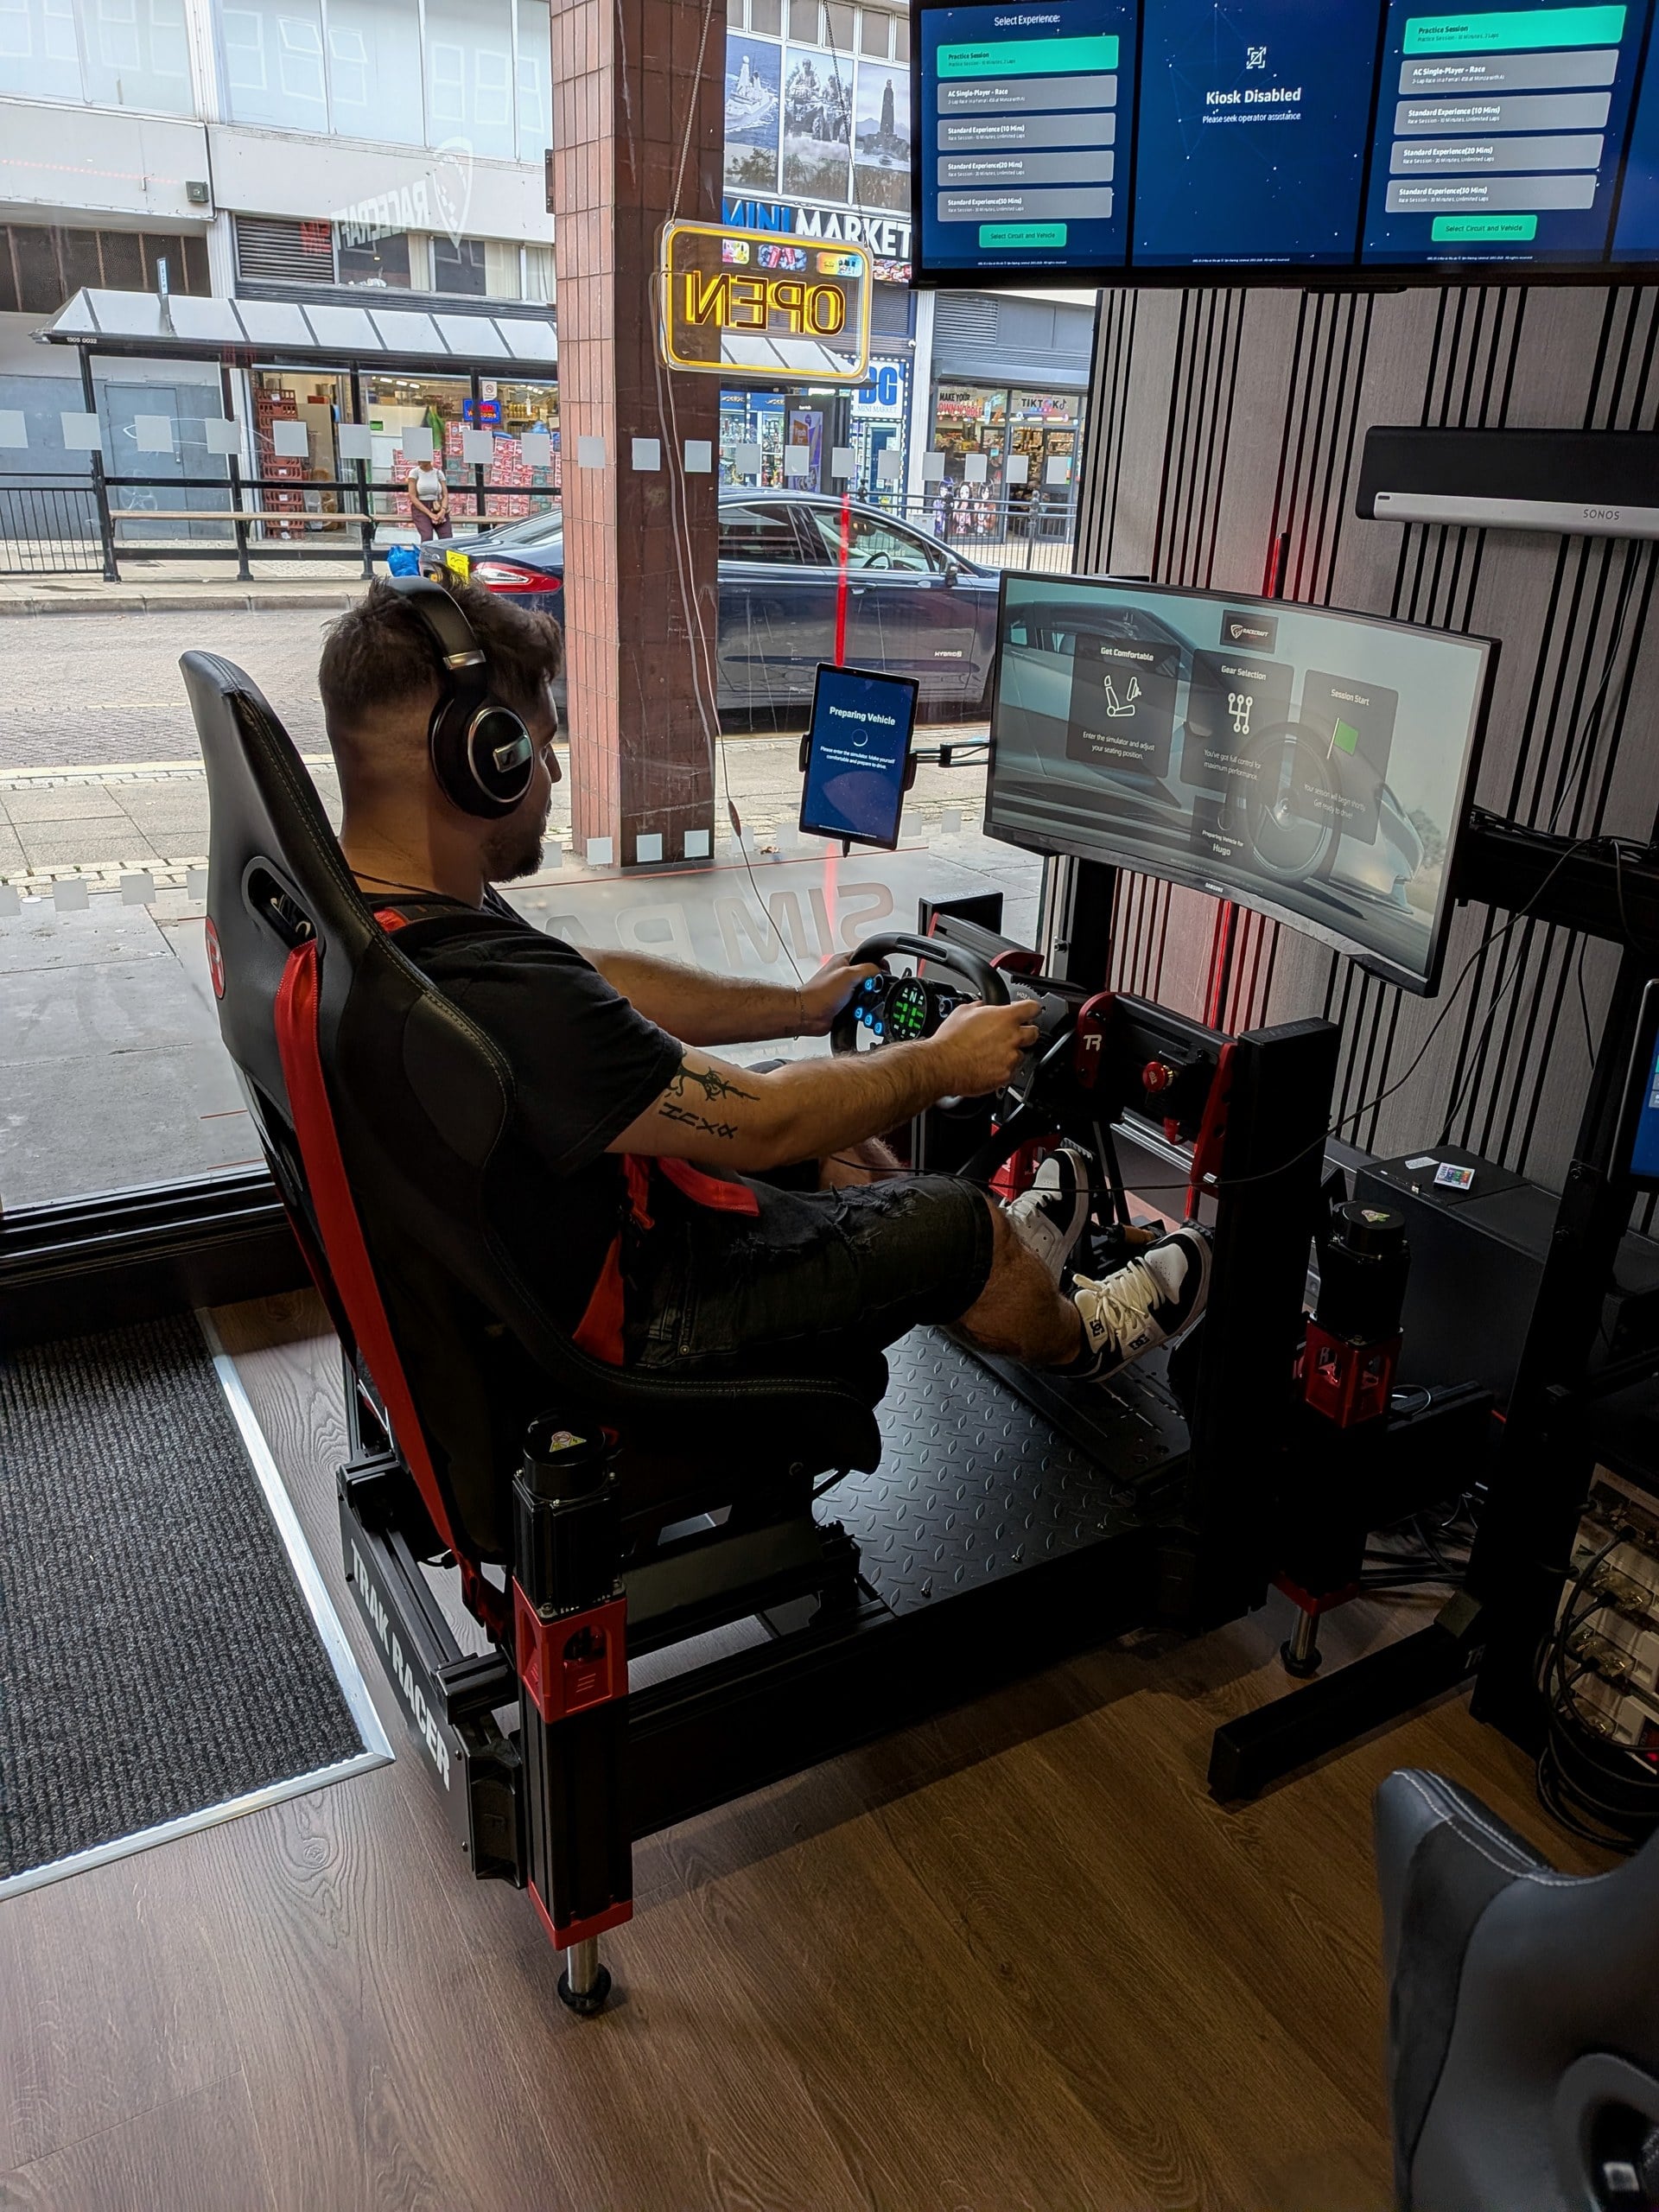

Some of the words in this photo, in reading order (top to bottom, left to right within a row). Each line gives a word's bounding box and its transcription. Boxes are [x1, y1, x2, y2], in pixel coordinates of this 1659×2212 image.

[994, 16, 1018, 26] Select
[1018, 14, 1060, 26] Experience:
[1422, 67, 1465, 76] Single-Player
[956, 89, 991, 98] Single-Player
[1206, 91, 1241, 105] Kiosk
[1244, 87, 1301, 103] Disabled
[1438, 107, 1471, 117] Experience
[1471, 107, 1482, 116] (10
[1483, 105, 1500, 114] Mins)
[1203, 114, 1223, 124] Please
[1224, 114, 1237, 123] seek
[1238, 114, 1266, 124] operator
[1433, 148, 1474, 156] Experience(20
[722, 197, 791, 233] MINI
[795, 207, 912, 258] MARKET
[938, 392, 955, 401] MAKE
[956, 392, 970, 402] YOUR
[1583, 509, 1620, 520] SONOS
[1243, 627, 1268, 638] RACECRAFT
[1113, 648, 1154, 661] Comfortable
[1221, 665, 1236, 675] Gear
[1237, 669, 1267, 681] Selection
[1331, 689, 1354, 702] Session
[1355, 695, 1370, 705] Start
[830, 706, 866, 722] Preparing
[868, 712, 896, 726] Vehicle
[1083, 731, 1096, 740] Enter
[1096, 733, 1106, 741] the
[1106, 735, 1128, 746] simulator
[1128, 740, 1139, 748] and
[1140, 741, 1154, 752] adjust
[1091, 744, 1104, 753] your
[1104, 747, 1122, 757] seating
[1122, 748, 1144, 760] position.
[1205, 749, 1220, 759] You've
[1220, 753, 1230, 762] got
[1237, 755, 1254, 767] control
[1205, 762, 1227, 772] maximum
[1227, 766, 1259, 781] performance.
[1314, 787, 1331, 798] session
[1338, 793, 1351, 807] begin
[1313, 799, 1322, 808] Get
[1322, 802, 1334, 814] ready
[1202, 830, 1222, 842] Preparing
[1223, 836, 1237, 845] Vehicle
[1212, 843, 1231, 856] Hugo
[909, 991, 918, 1004] N
[353, 1557, 391, 1656] TRAK
[392, 1640, 450, 1792] RACER
